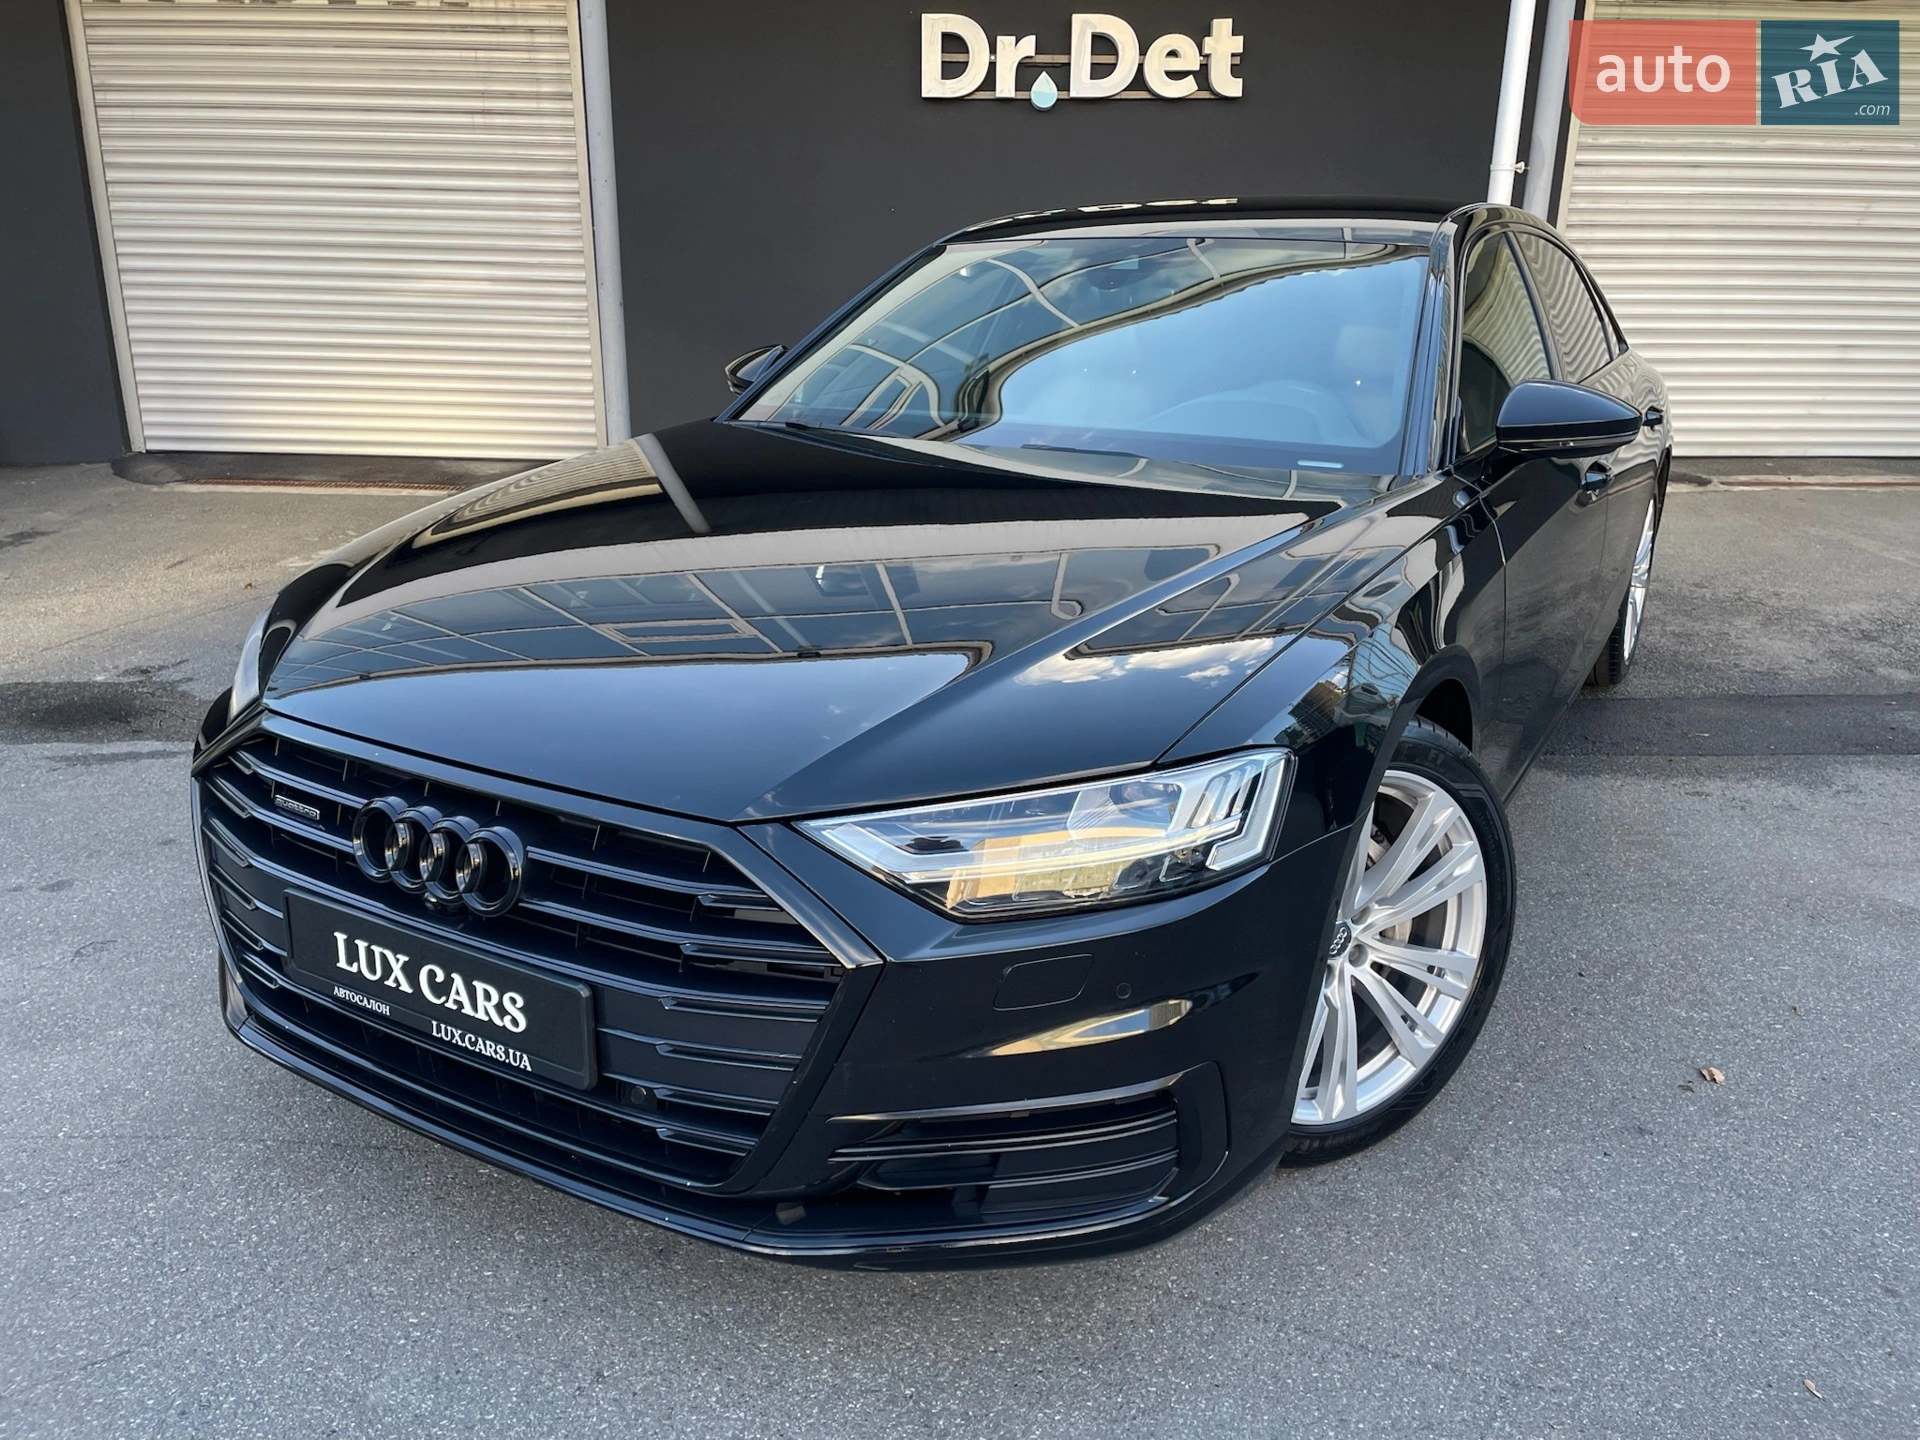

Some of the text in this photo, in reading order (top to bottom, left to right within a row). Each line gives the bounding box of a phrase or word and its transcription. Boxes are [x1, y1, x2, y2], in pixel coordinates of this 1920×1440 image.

[333, 931, 527, 1033] LUX CARS
[333, 985, 391, 1016] АВТОСАЛОН
[431, 1020, 533, 1072] LUX.CARS.UA
